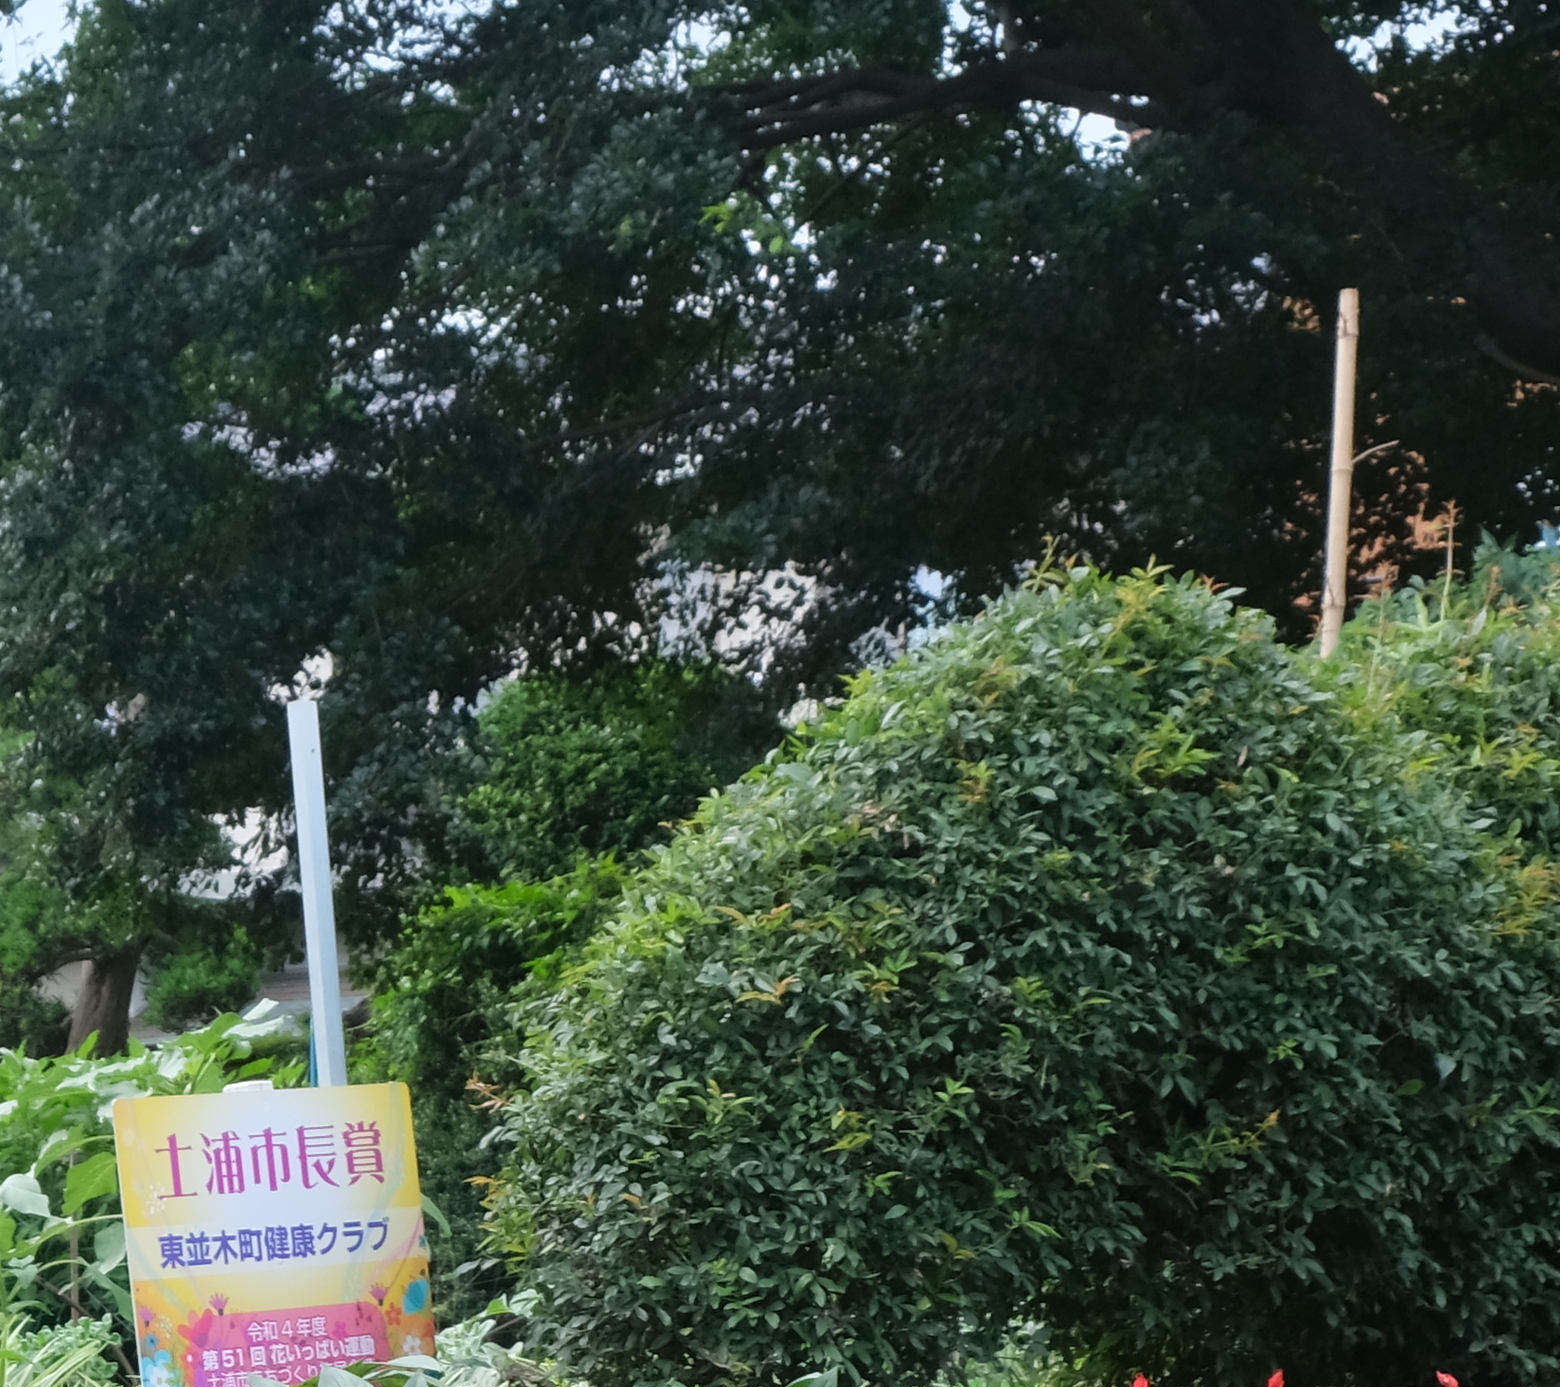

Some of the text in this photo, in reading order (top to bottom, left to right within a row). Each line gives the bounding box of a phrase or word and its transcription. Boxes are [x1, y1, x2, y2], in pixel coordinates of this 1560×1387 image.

[154, 1120, 386, 1200] 土浦市長賞
[157, 1217, 390, 1269] 東並木町健康クラブ
[247, 1316, 328, 1342] 令和4年度
